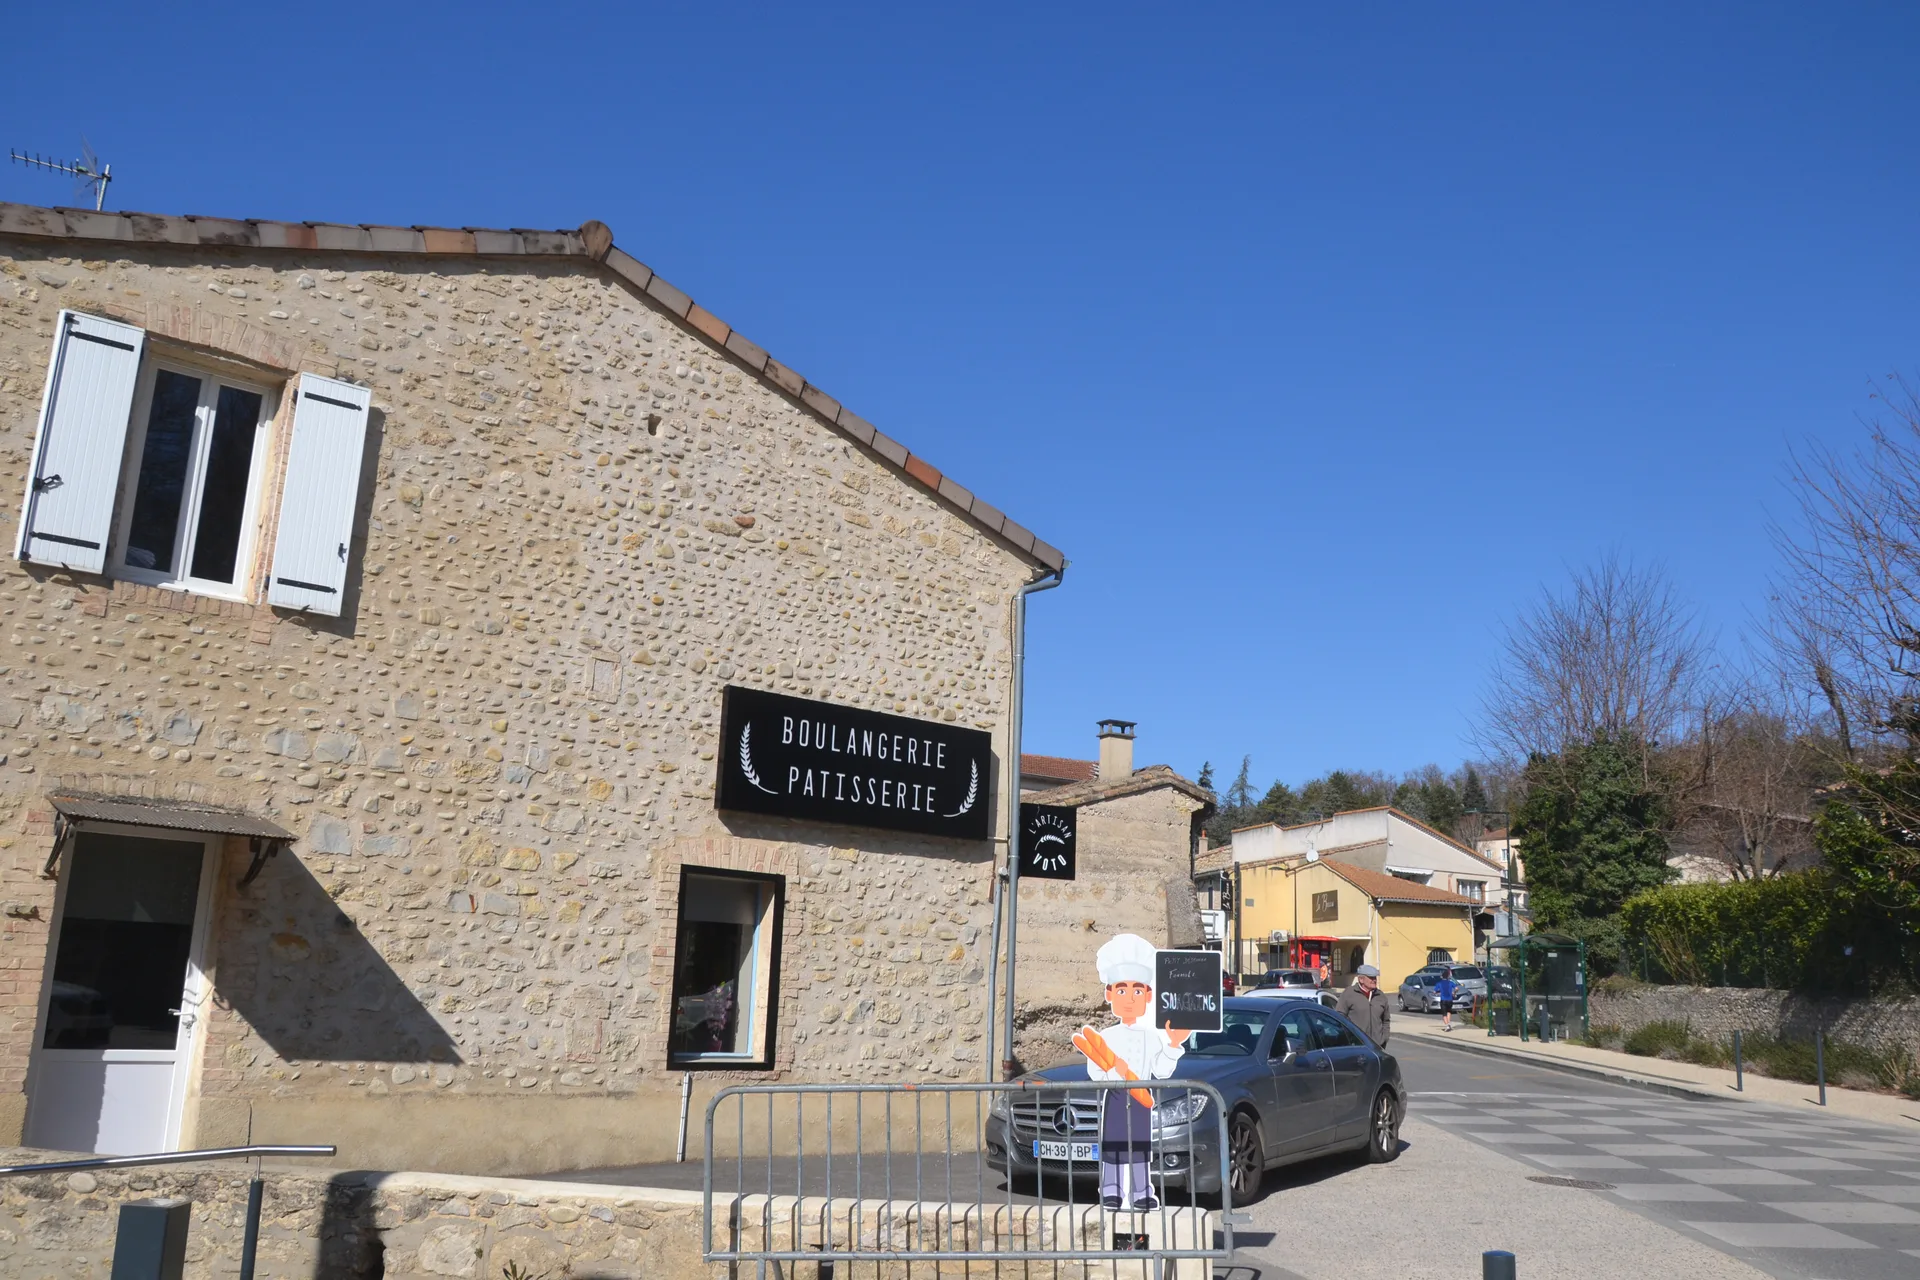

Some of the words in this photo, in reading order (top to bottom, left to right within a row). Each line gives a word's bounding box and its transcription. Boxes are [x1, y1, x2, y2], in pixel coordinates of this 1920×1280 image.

[782, 716, 947, 769] BOULANGERIE
[788, 766, 936, 813] PATISSERIE
[1028, 814, 1072, 838] L'ARTISAN
[1033, 853, 1067, 871] VOTO
